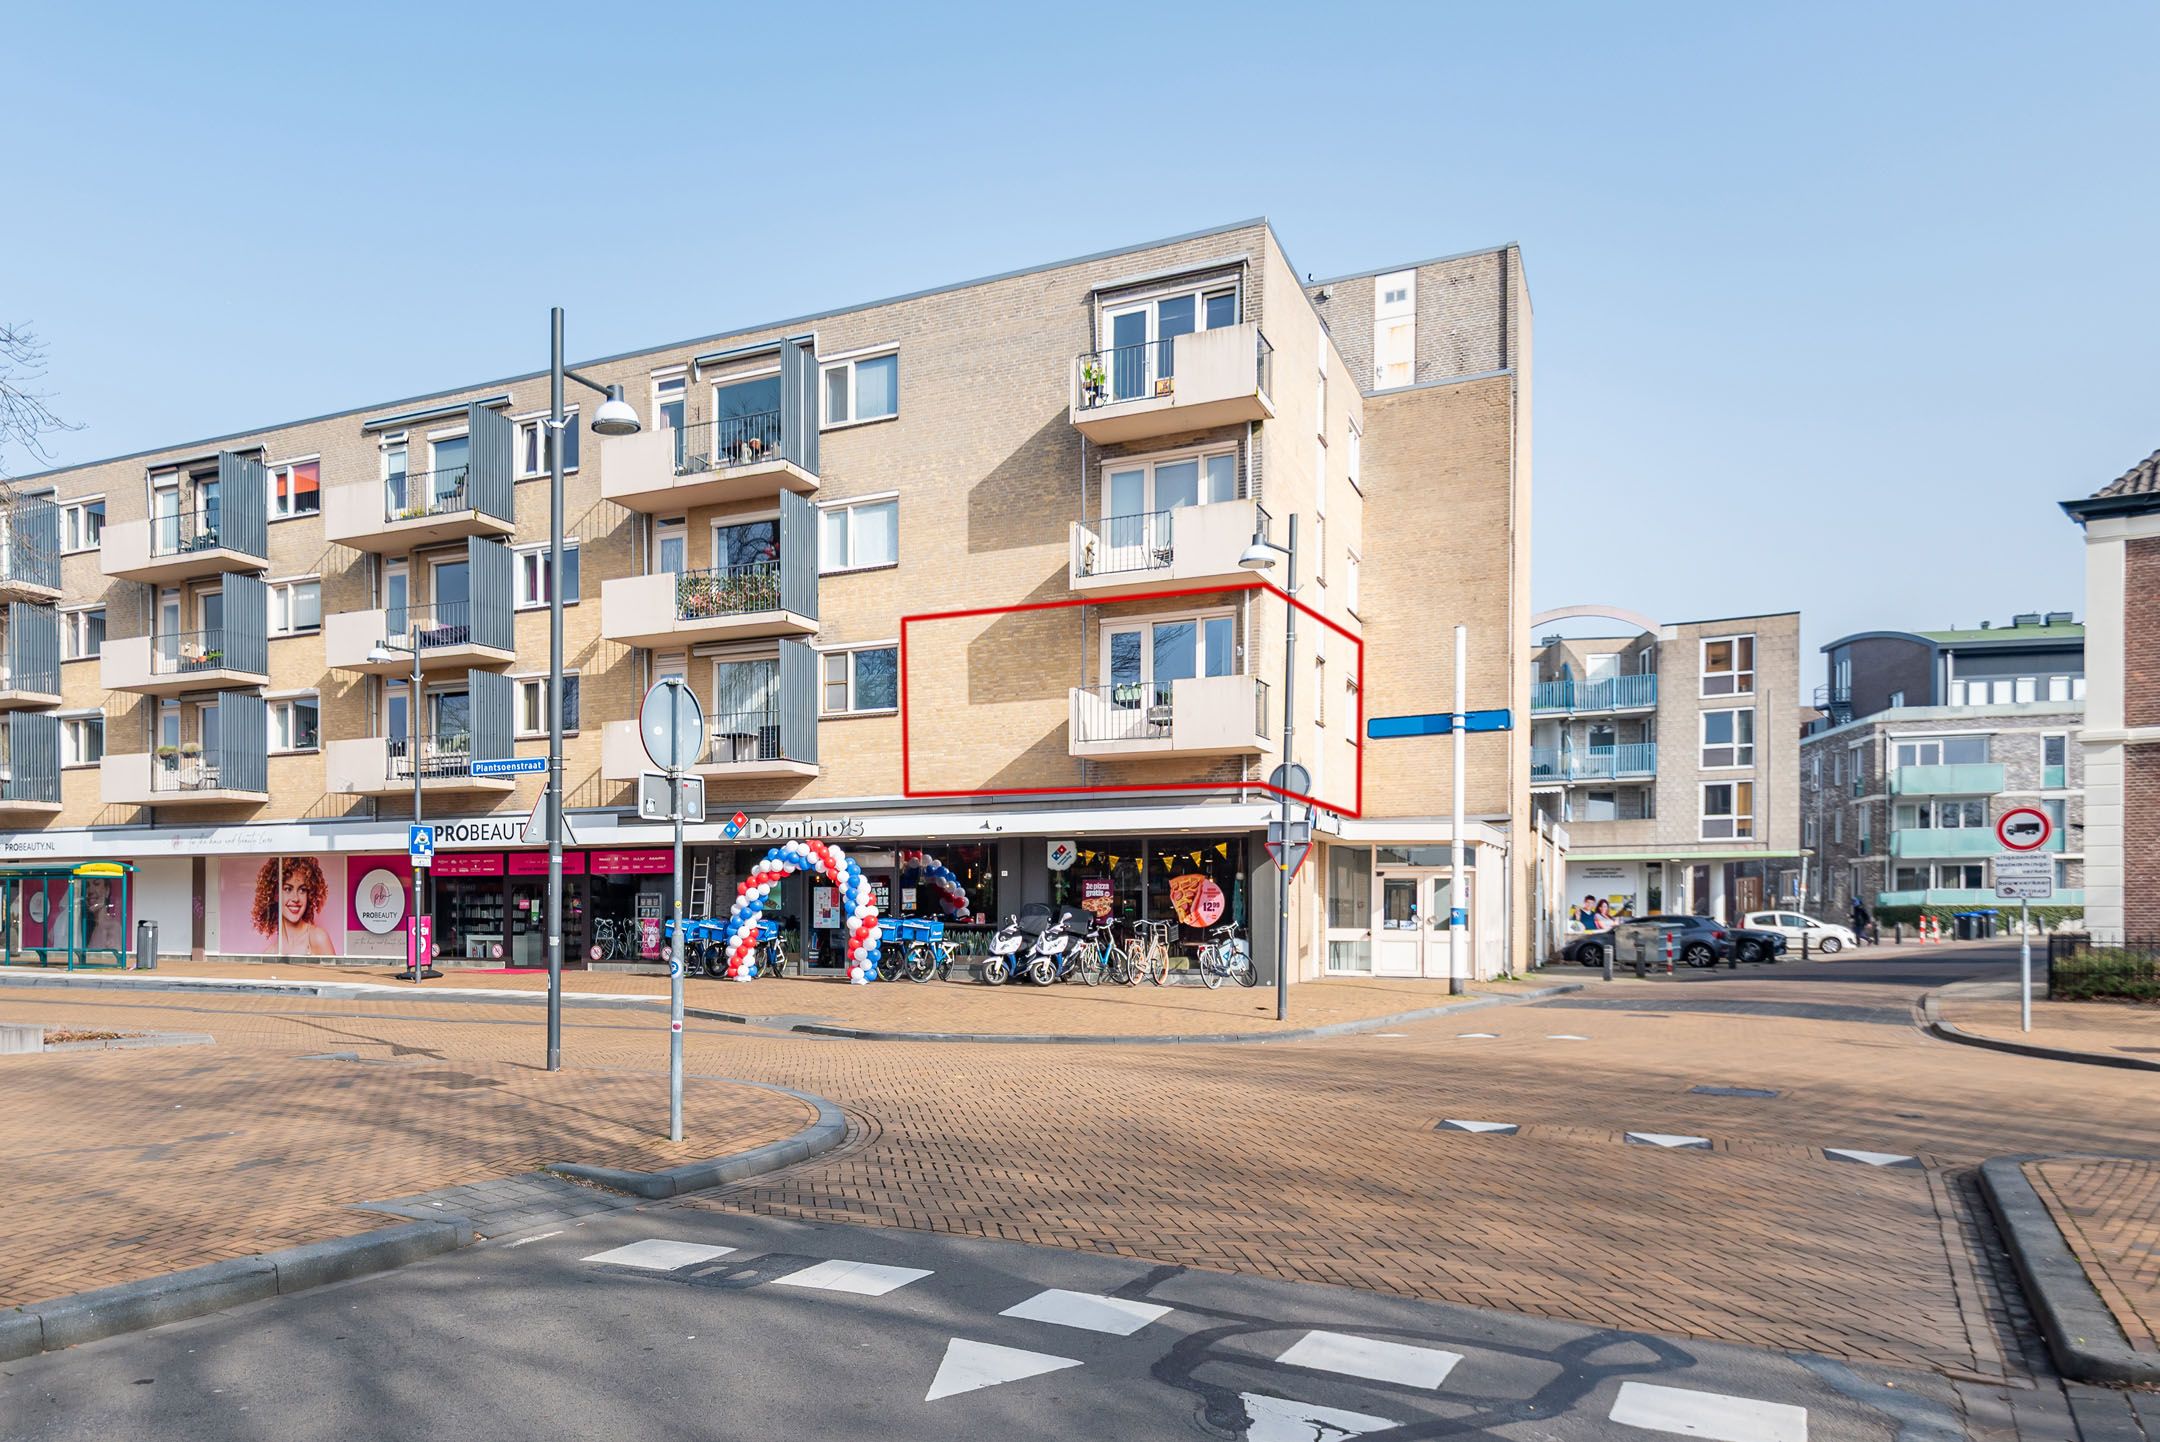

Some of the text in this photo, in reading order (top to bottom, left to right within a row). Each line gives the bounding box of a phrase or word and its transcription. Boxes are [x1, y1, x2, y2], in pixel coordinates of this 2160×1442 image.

[475, 761, 542, 773] Plantsoenstraat
[433, 822, 527, 842] PROBEAUT
[749, 815, 863, 839] Domino's
[4, 842, 55, 851] PROBEAUTY.NL
[871, 887, 889, 896] ASH
[362, 911, 398, 919] PROBEAUTY
